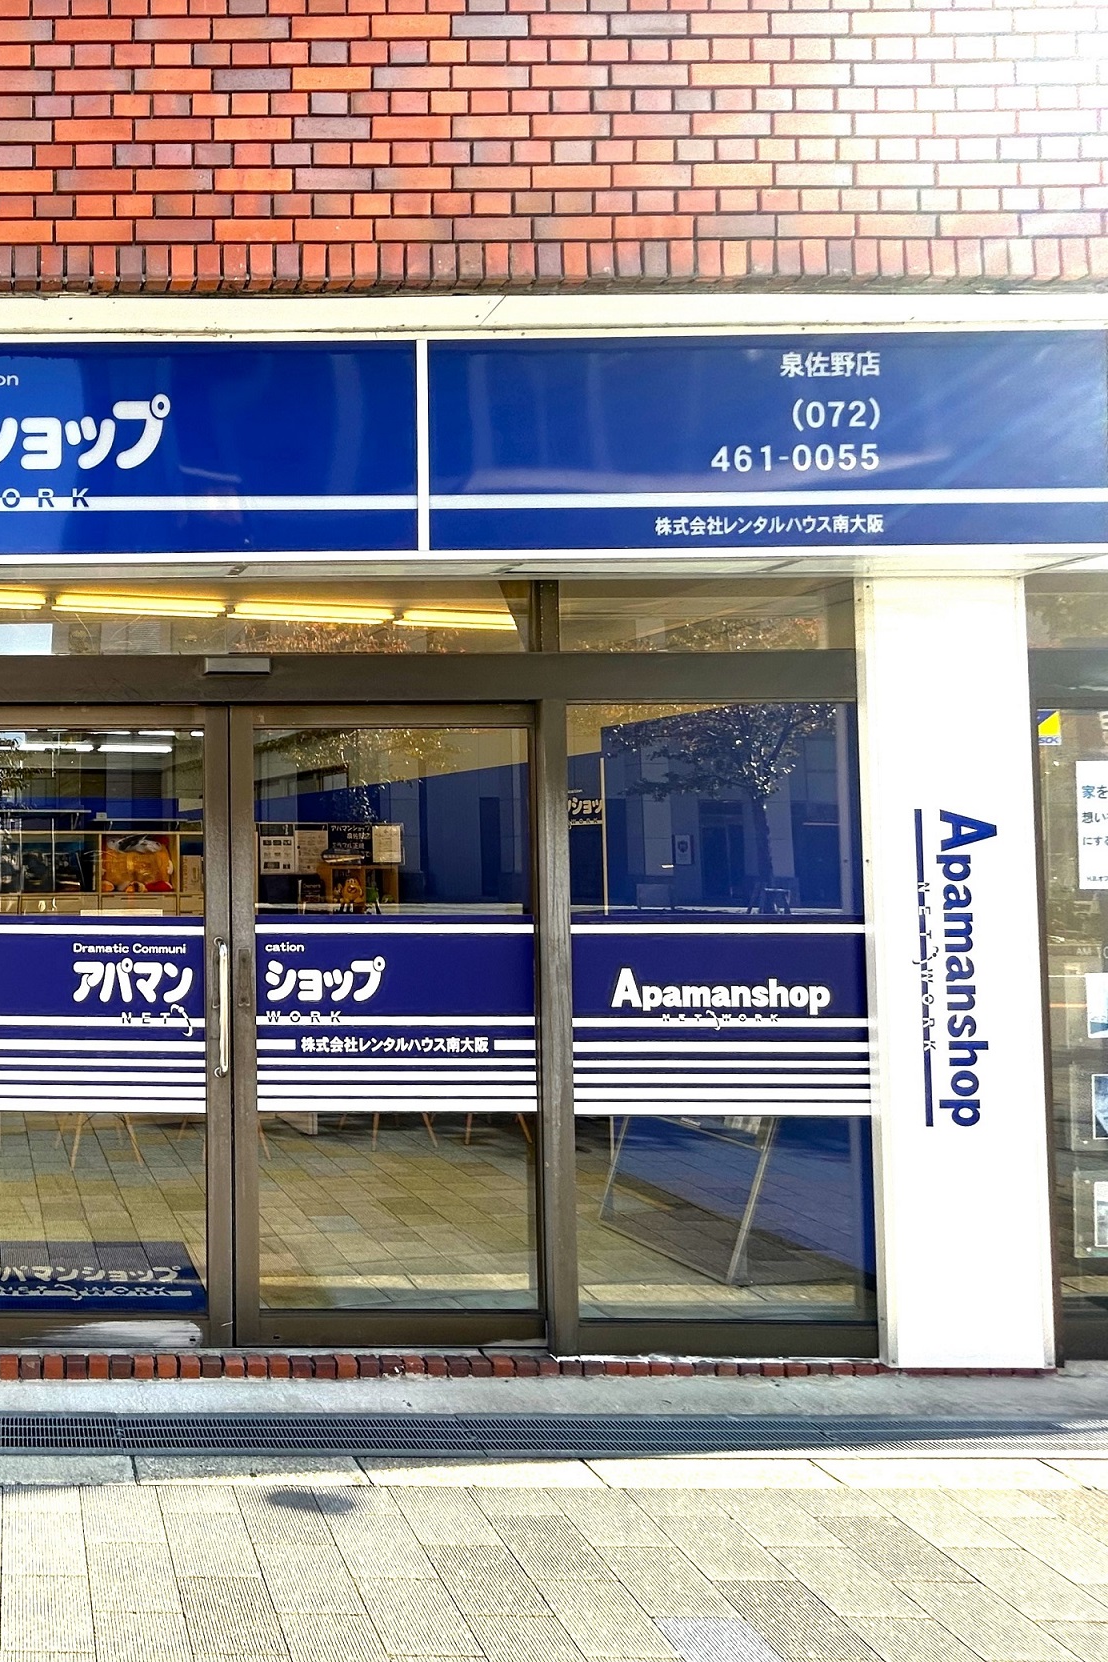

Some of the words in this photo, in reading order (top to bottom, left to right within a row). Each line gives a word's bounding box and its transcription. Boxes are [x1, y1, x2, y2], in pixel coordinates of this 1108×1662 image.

[781, 351, 882, 379] 泉佐野店
[793, 398, 882, 431] (072)
[712, 444, 882, 473] 461-0055
[655, 514, 885, 537] 株式会社レンタルハウス南大阪
[1038, 736, 1060, 744] SOK
[1081, 812, 1108, 824] 想い
[73, 943, 129, 954] Dramatic
[132, 943, 186, 954] Communi
[265, 942, 305, 953] cation
[265, 956, 386, 1003] ショップ
[936, 808, 998, 1127] Apamanshop
[73, 958, 193, 1003] アパマン
[611, 968, 831, 1015] Apamanshop
[266, 1010, 342, 1023] WORK
[300, 1036, 490, 1055] 株式会社レンタルハウス南大阪
